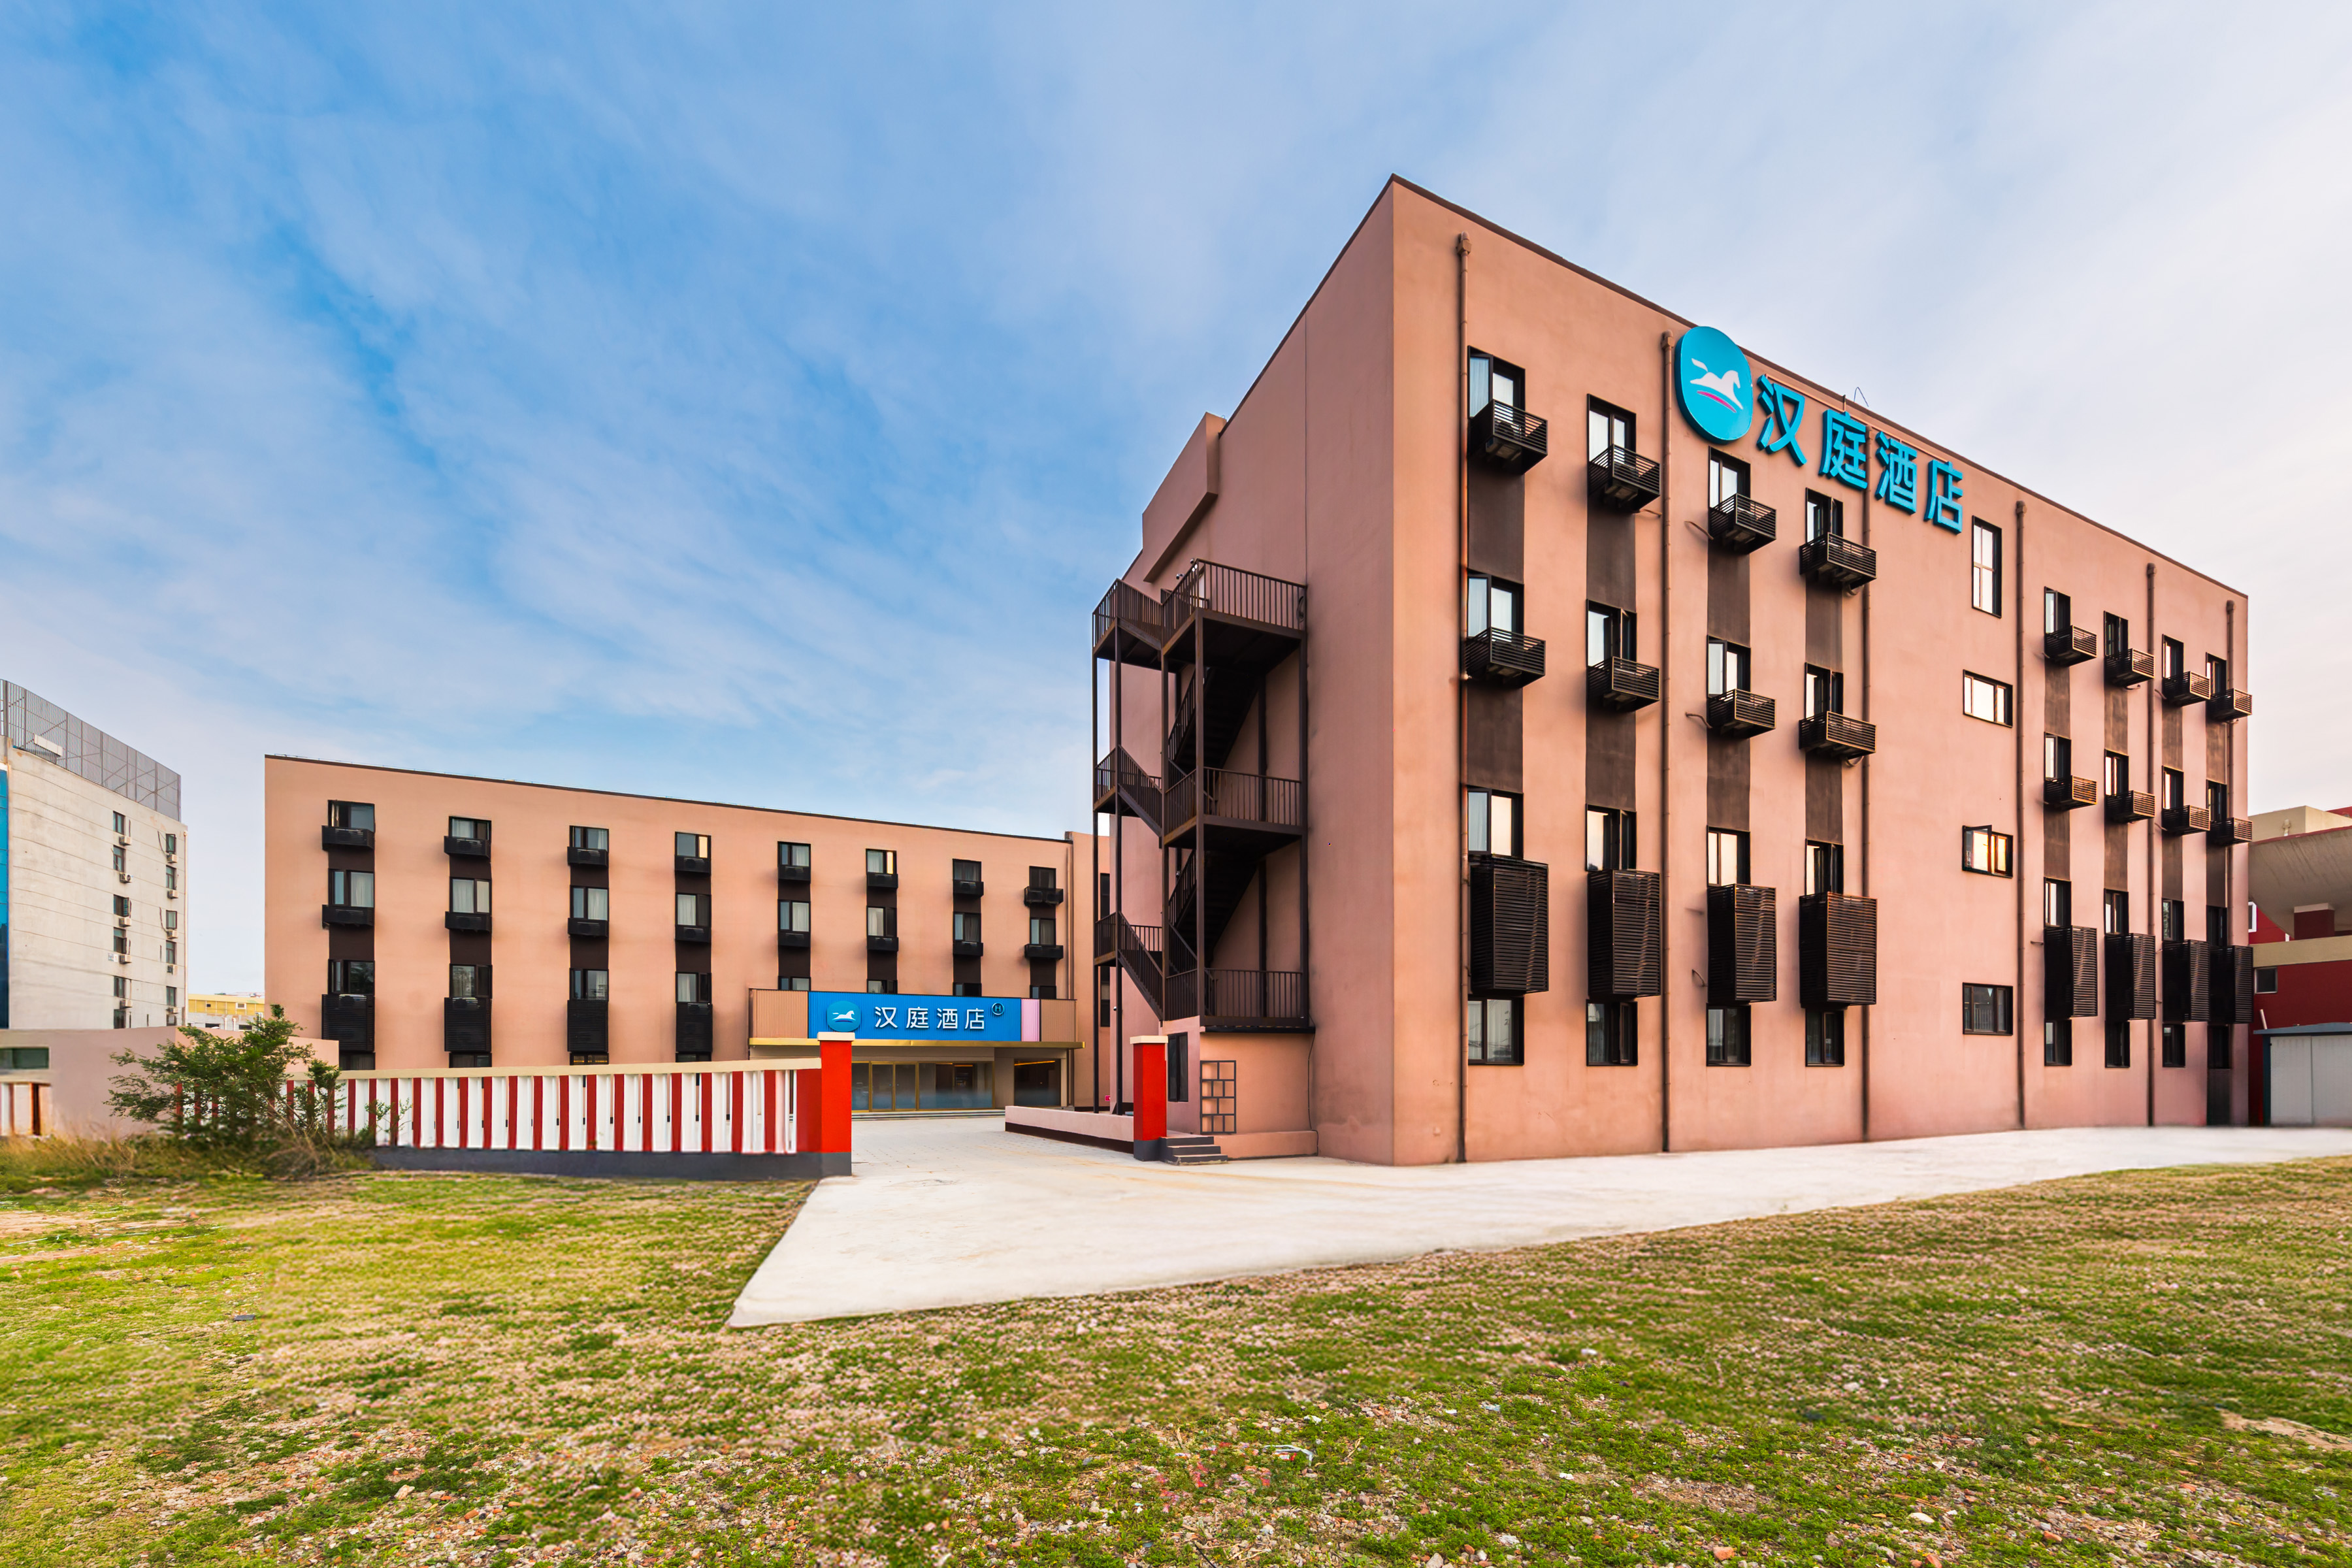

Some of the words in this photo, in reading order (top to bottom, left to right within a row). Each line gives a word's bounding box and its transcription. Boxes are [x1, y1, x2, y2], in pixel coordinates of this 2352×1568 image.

[1757, 374, 1963, 534] 汉庭酒店
[875, 1006, 985, 1029] 汉庭酒店
